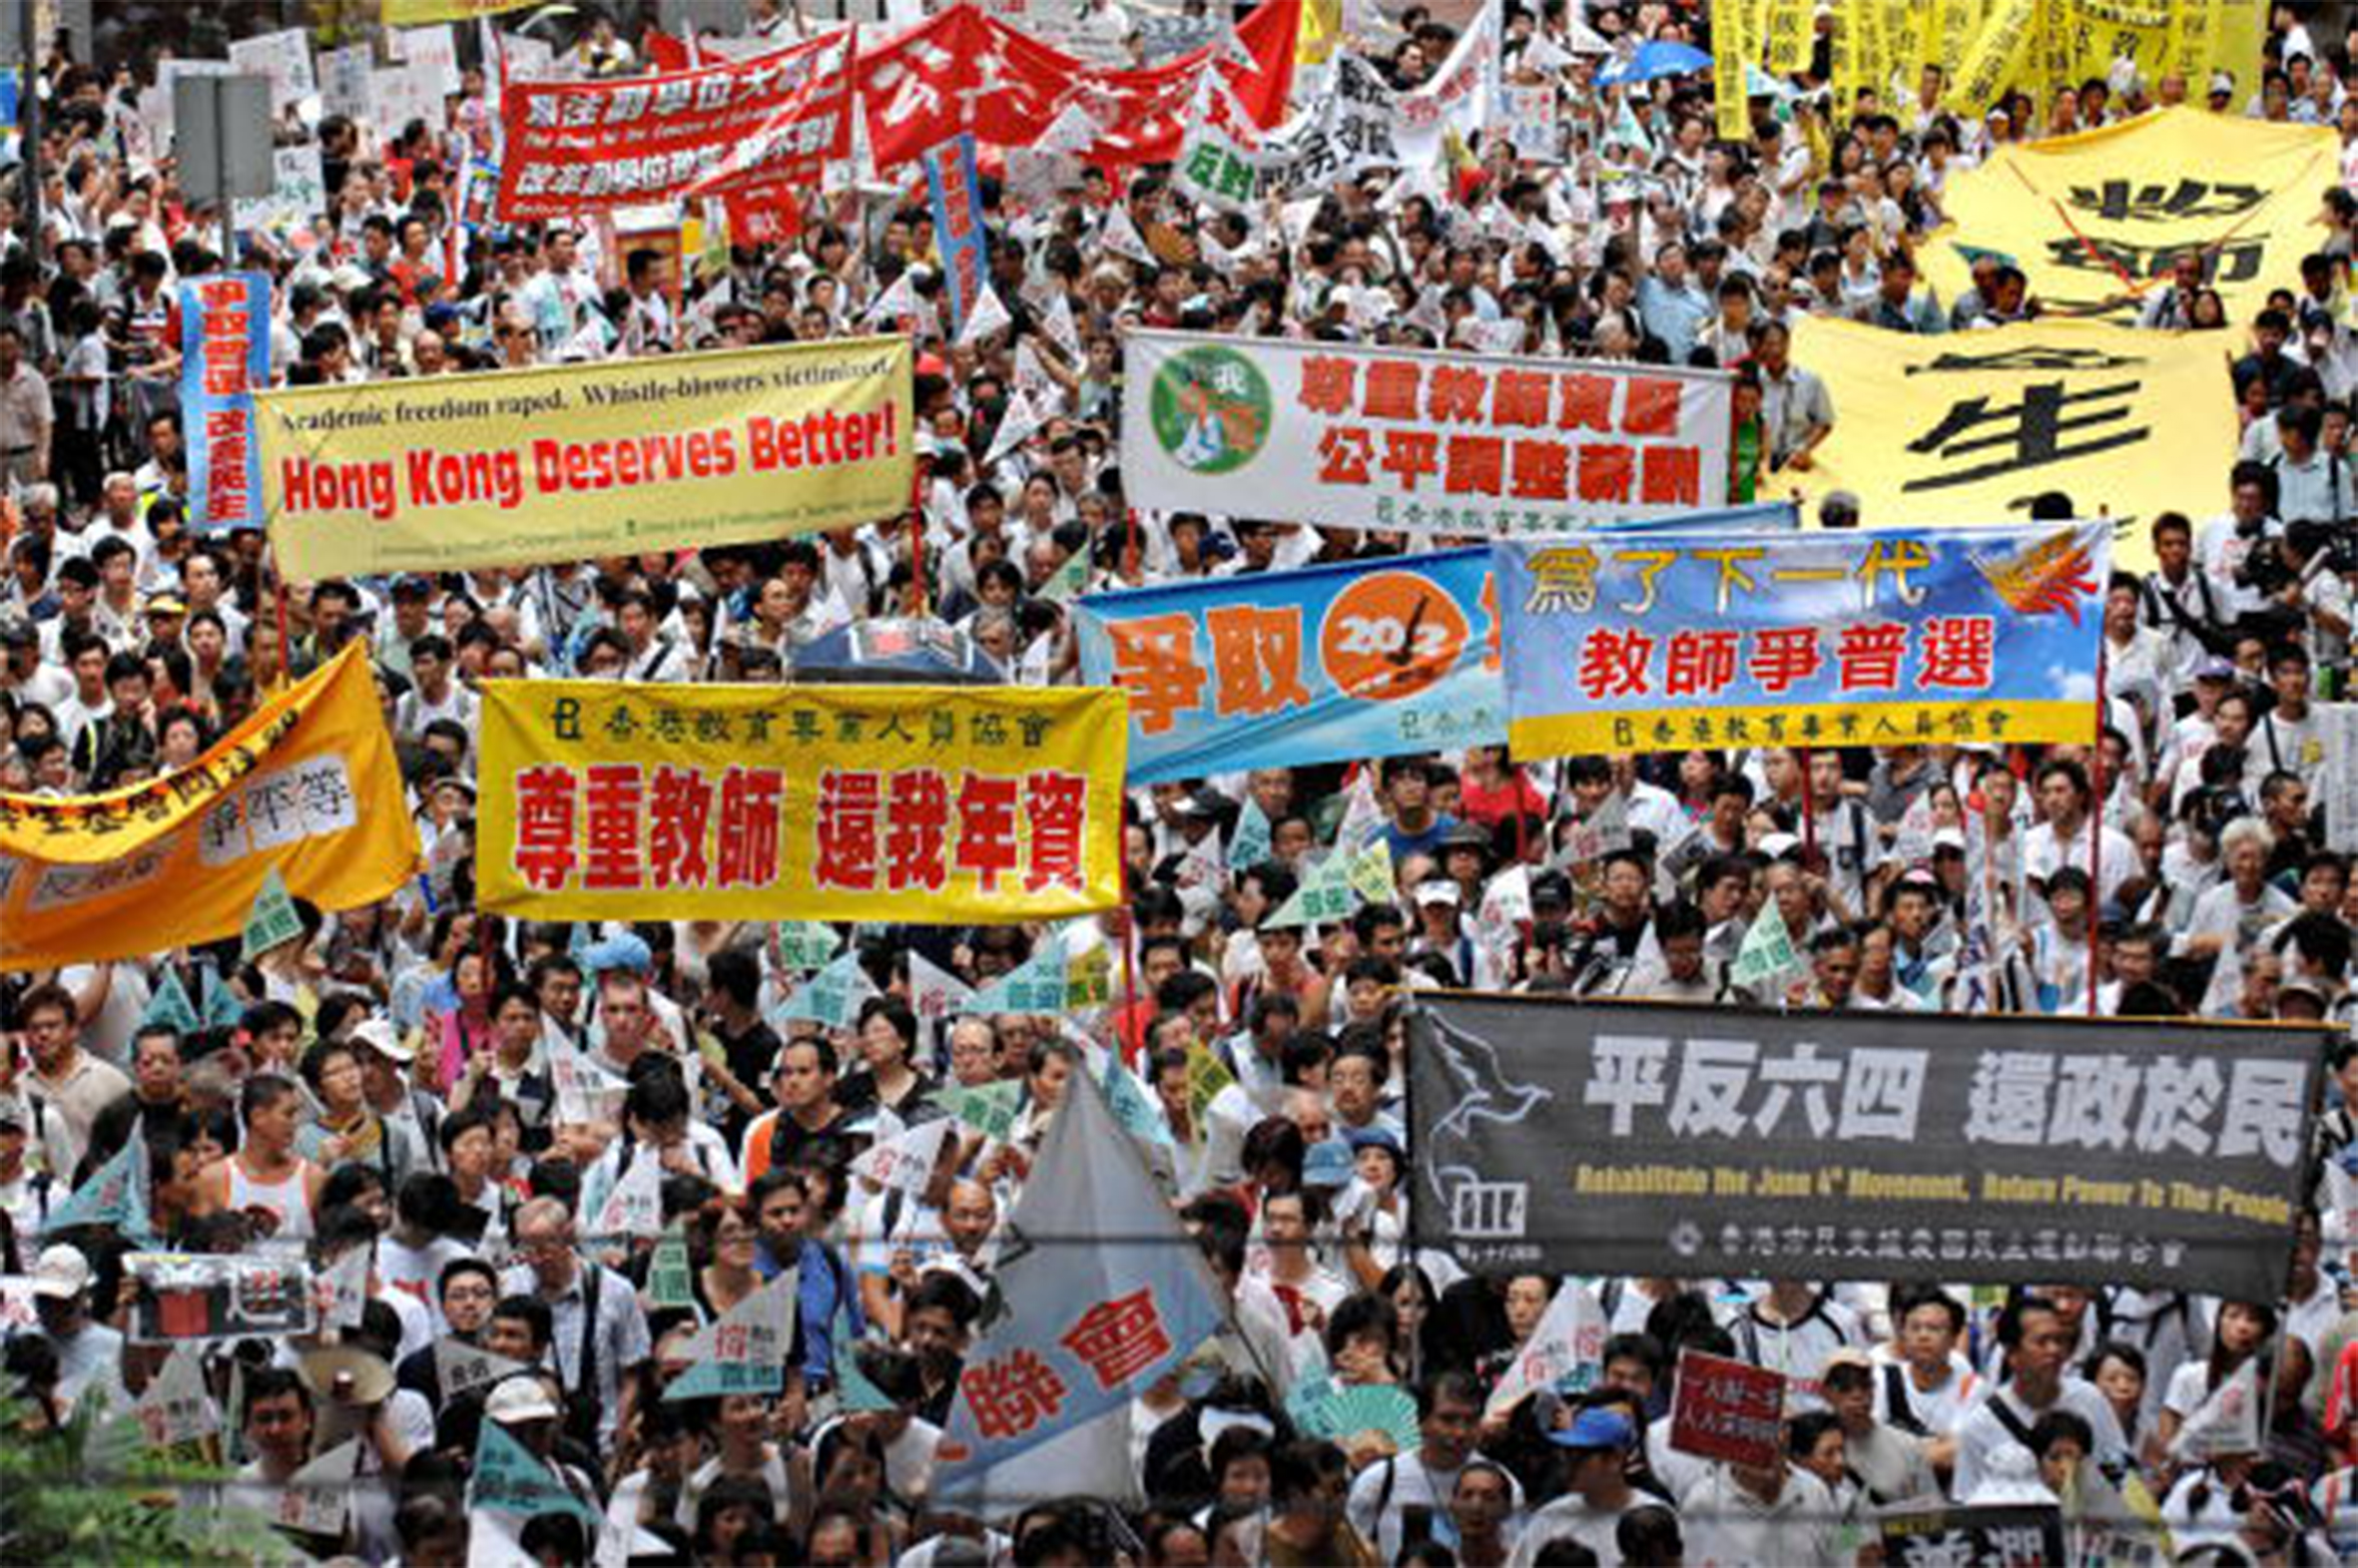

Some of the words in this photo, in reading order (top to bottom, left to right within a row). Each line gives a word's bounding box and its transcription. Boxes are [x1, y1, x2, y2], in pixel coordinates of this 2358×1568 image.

[283, 456, 397, 520] Hong
[406, 448, 525, 509] Kong
[531, 428, 737, 493] Deserves
[747, 399, 897, 472] Better!
[1105, 605, 1311, 737] 爭取
[1578, 614, 1994, 701] 教師爭普選
[514, 764, 785, 891] 尊重教師
[813, 766, 1087, 892] 還我年資
[1582, 1034, 1931, 1142] 平反六四
[1963, 1049, 2308, 1169] 還政於民
[1575, 1164, 1710, 1195] Rehabilitate
[1713, 1167, 1749, 1196] the
[1754, 1168, 1812, 1197] June
[2063, 1174, 2133, 1207] Power
[2140, 1177, 2165, 1209] To
[2168, 1180, 2214, 1213] The
